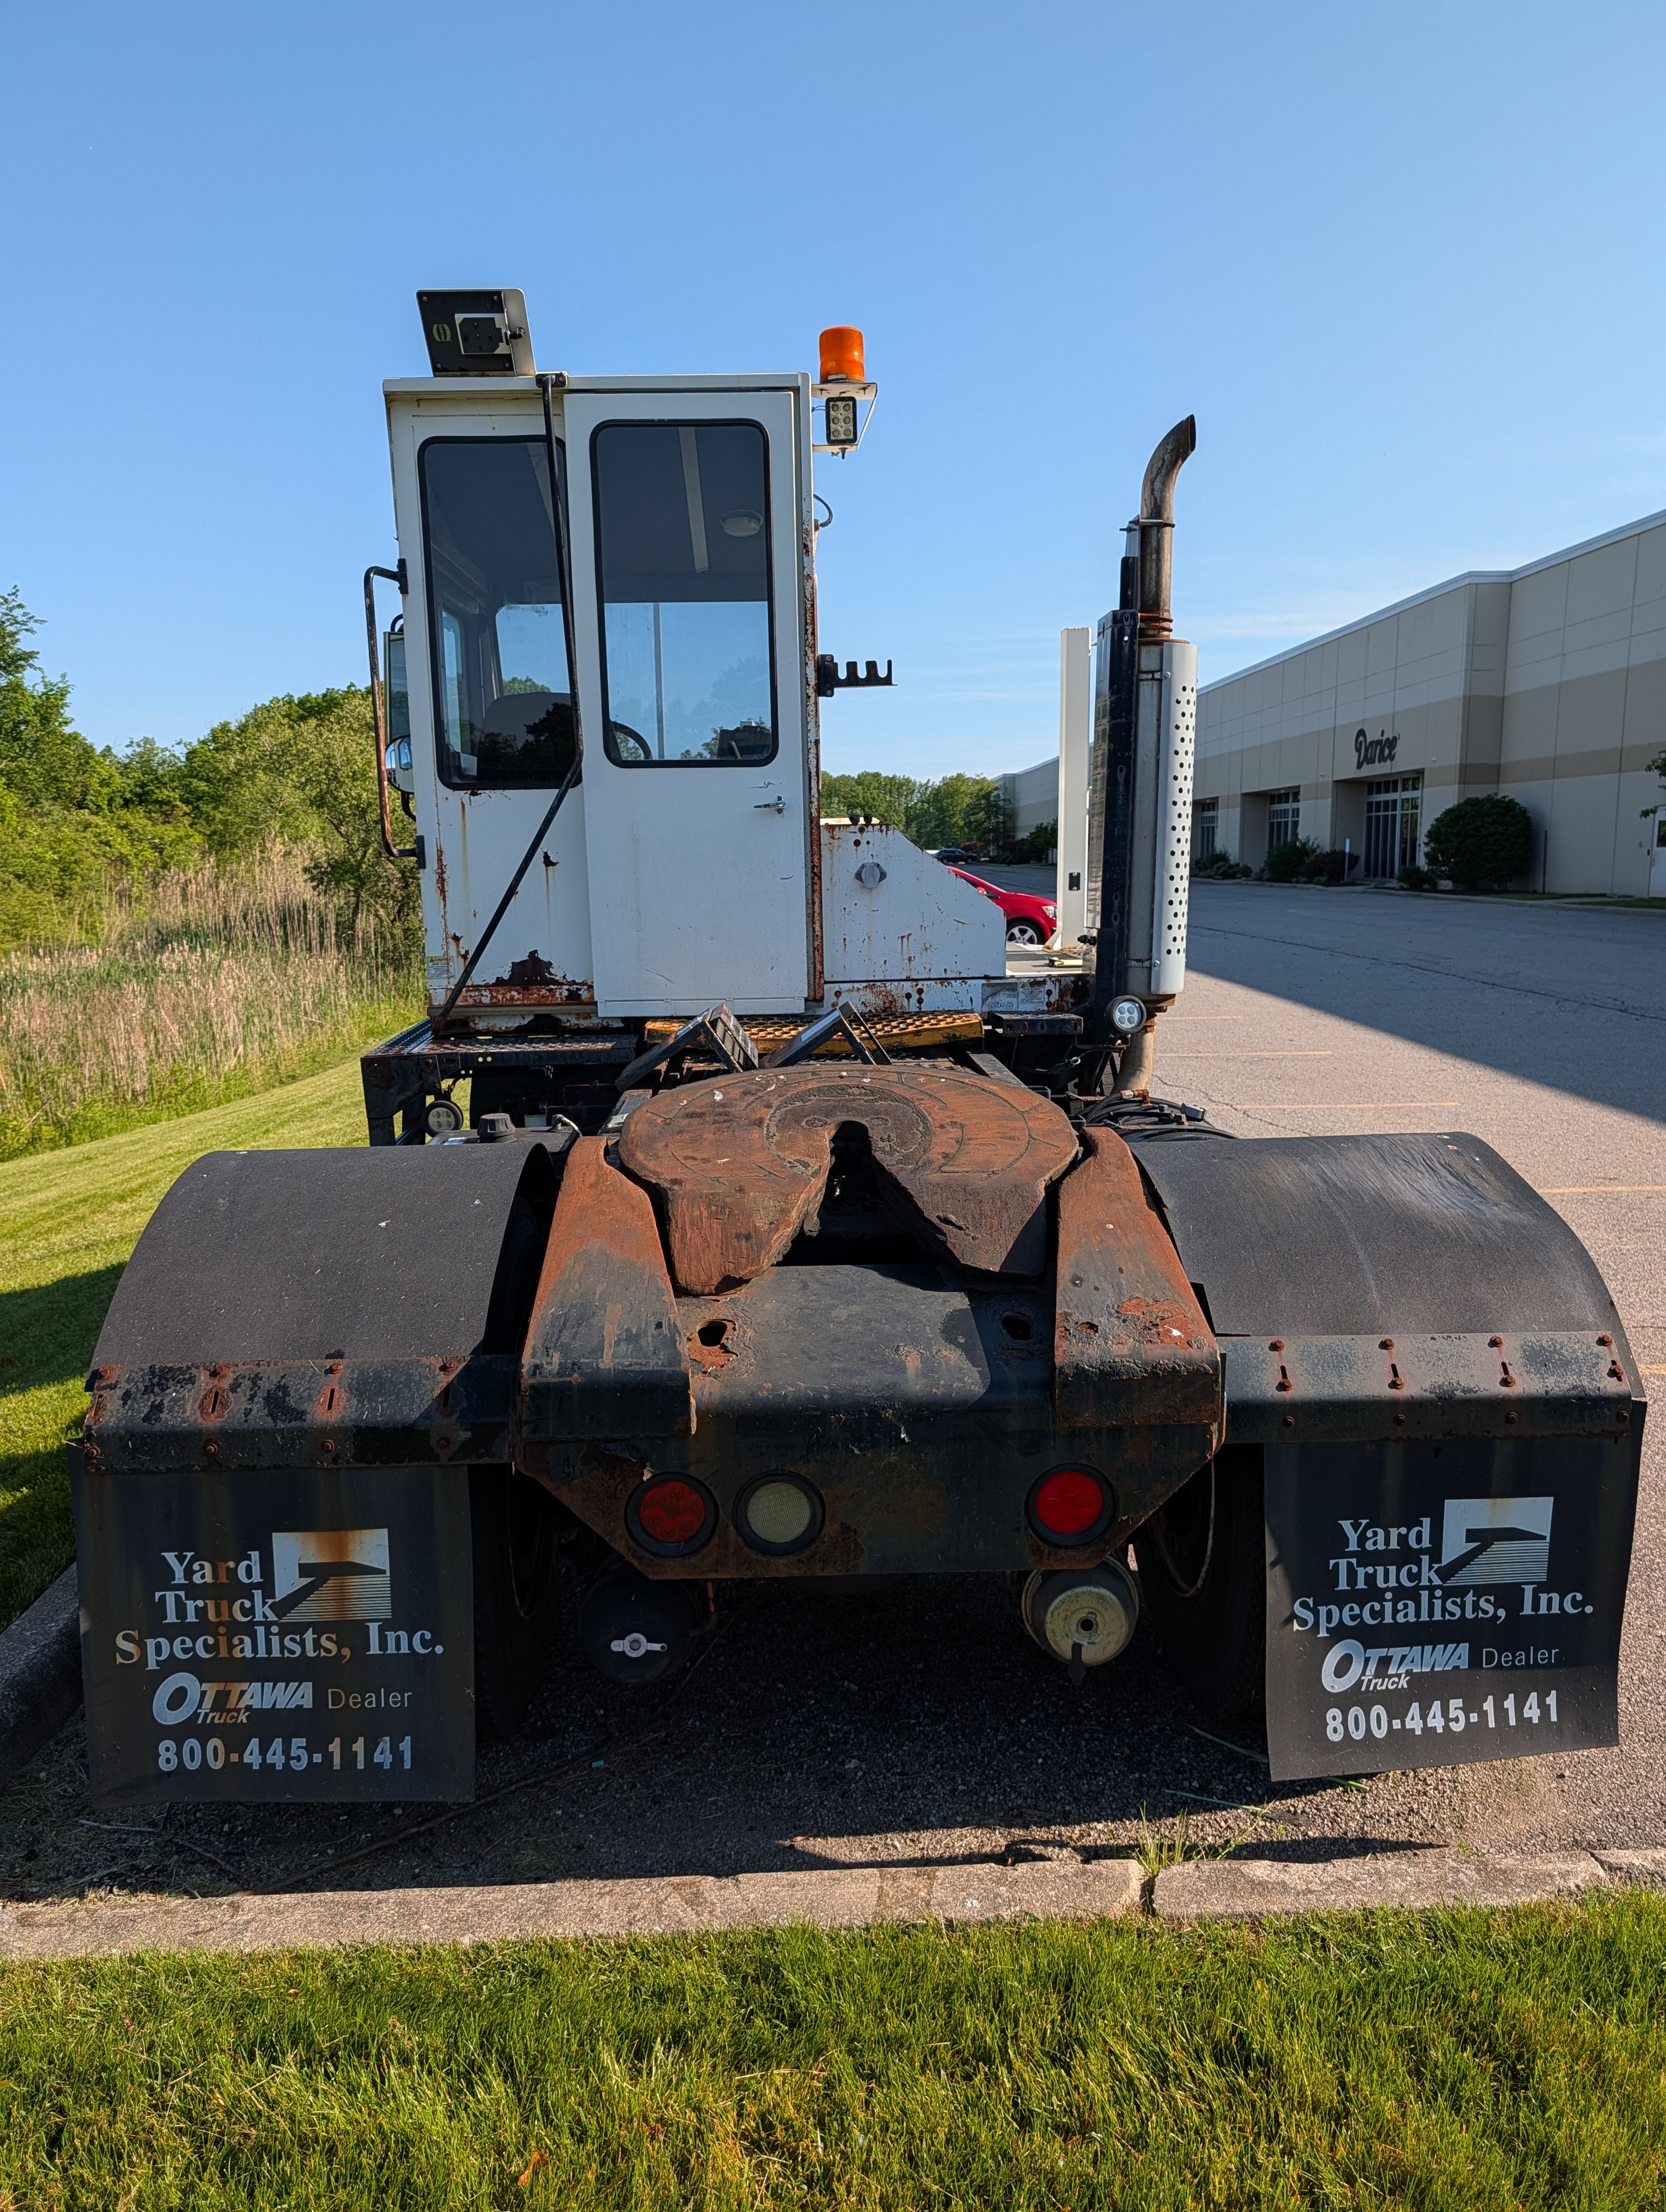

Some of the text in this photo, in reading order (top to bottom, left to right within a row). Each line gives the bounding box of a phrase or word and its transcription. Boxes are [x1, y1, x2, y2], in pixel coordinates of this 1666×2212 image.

[1354, 728, 1397, 770] Darice
[1338, 1518, 1432, 1551] Yard
[161, 1551, 263, 1584] Yard
[1329, 1555, 1443, 1590] Truck
[155, 1590, 279, 1623] Truck
[1293, 1585, 1594, 1637] Specialists, Inc.
[115, 1622, 444, 1670] Specialists, Inc.
[1322, 1639, 1559, 1692] OTTAWA Dealer
[1361, 1674, 1410, 1691] Truck
[153, 1672, 412, 1725] OTTAWA Dealer
[1326, 1690, 1558, 1742] 800-445-1141
[197, 1709, 250, 1724] Truck
[158, 1736, 411, 1771] 800-445-1141
